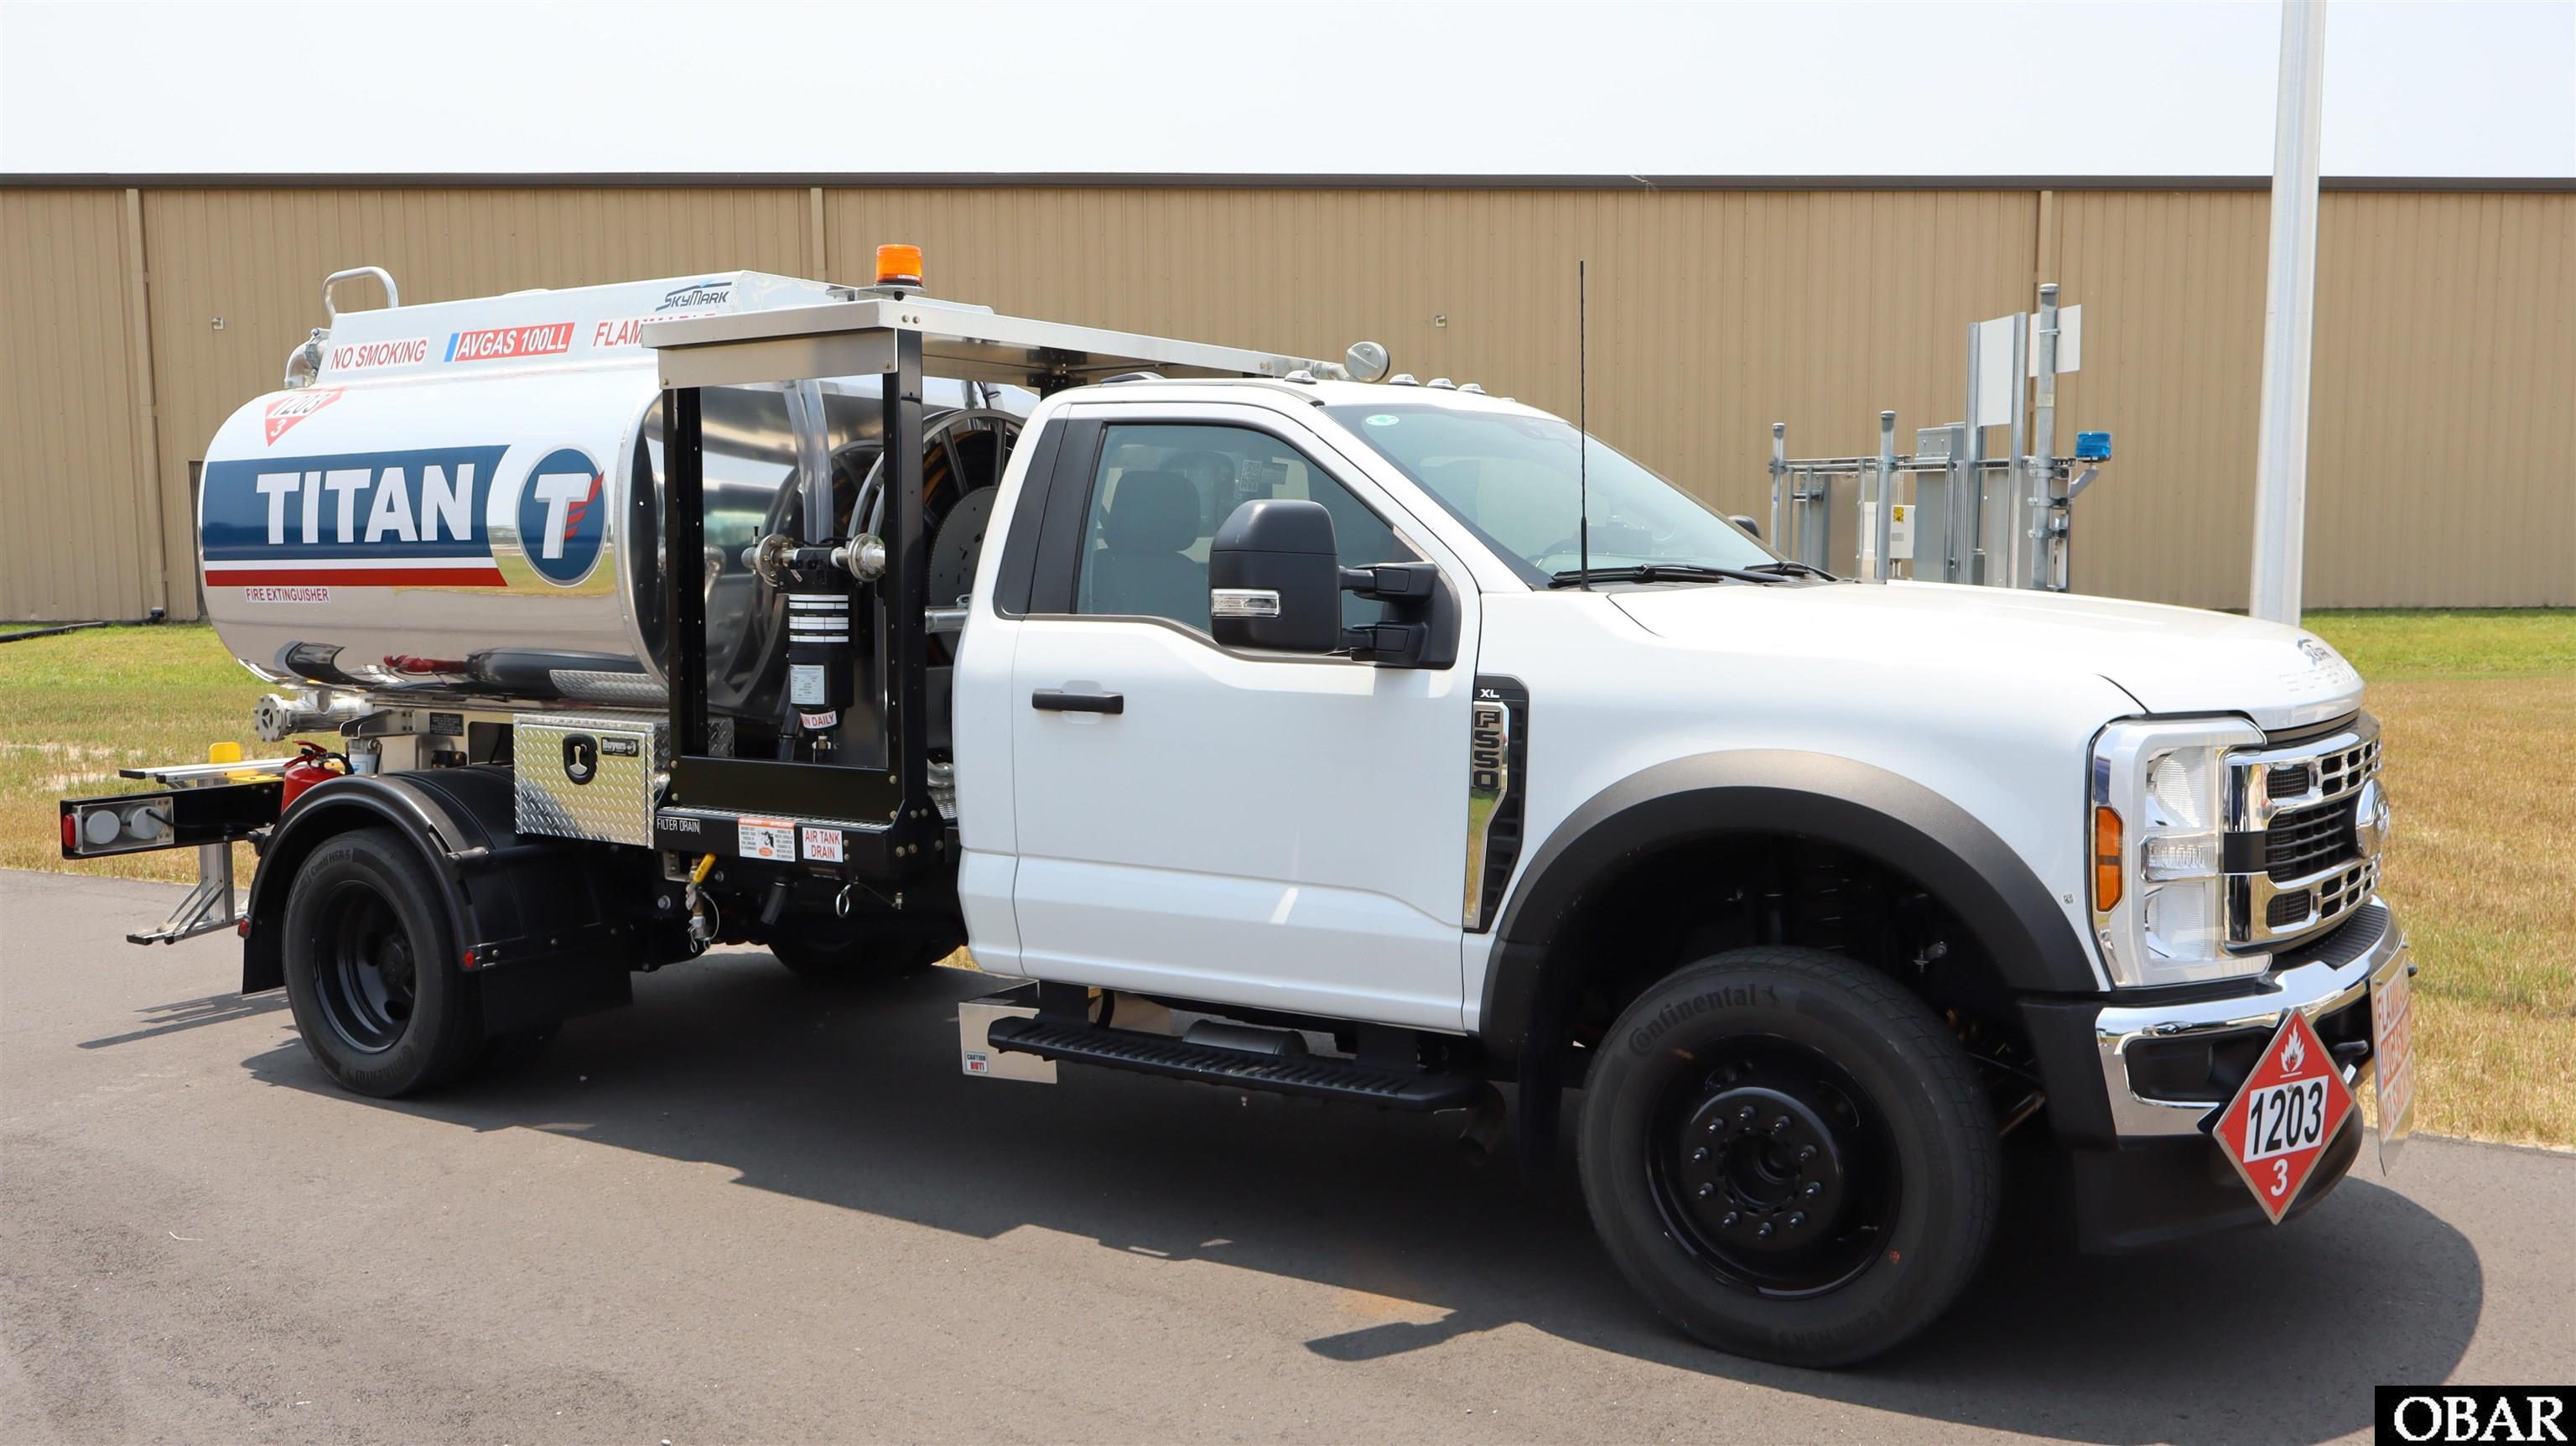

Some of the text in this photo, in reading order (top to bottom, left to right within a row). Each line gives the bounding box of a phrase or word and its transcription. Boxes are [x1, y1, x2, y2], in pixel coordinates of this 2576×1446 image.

[330, 339, 428, 370] NO SMOKING
[457, 326, 568, 357] AVGAS 100LL
[269, 419, 288, 437] 3
[255, 463, 475, 544] TITAN
[534, 473, 594, 559] T
[246, 588, 330, 601] FIRE EXTINGUISHER
[1480, 689, 1500, 699] XL
[812, 713, 834, 727] DAILY
[1474, 710, 1501, 792] F550
[657, 818, 701, 833] FILTER DRAIN
[805, 830, 840, 845] AIR TANK
[811, 845, 835, 860] DRAIN
[1628, 982, 1758, 1058] Continental
[2250, 1080, 2323, 1156] 1203
[2270, 1157, 2288, 1197] 3
